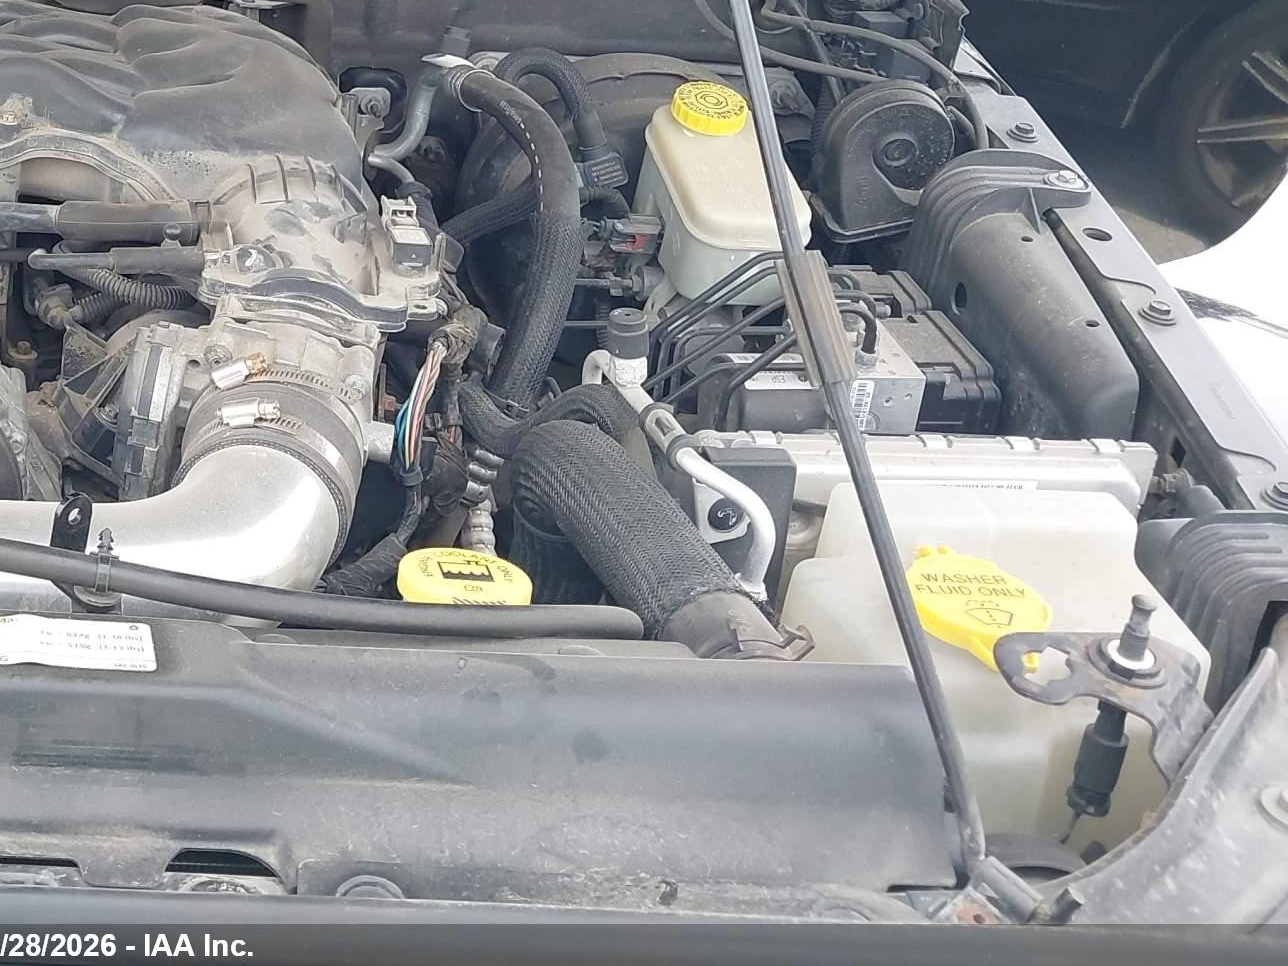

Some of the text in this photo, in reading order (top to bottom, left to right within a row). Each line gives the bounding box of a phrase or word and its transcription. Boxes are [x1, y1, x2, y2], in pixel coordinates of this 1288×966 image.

[920, 572, 1007, 586] WASHER
[914, 584, 1027, 598] FLUID ONLY
